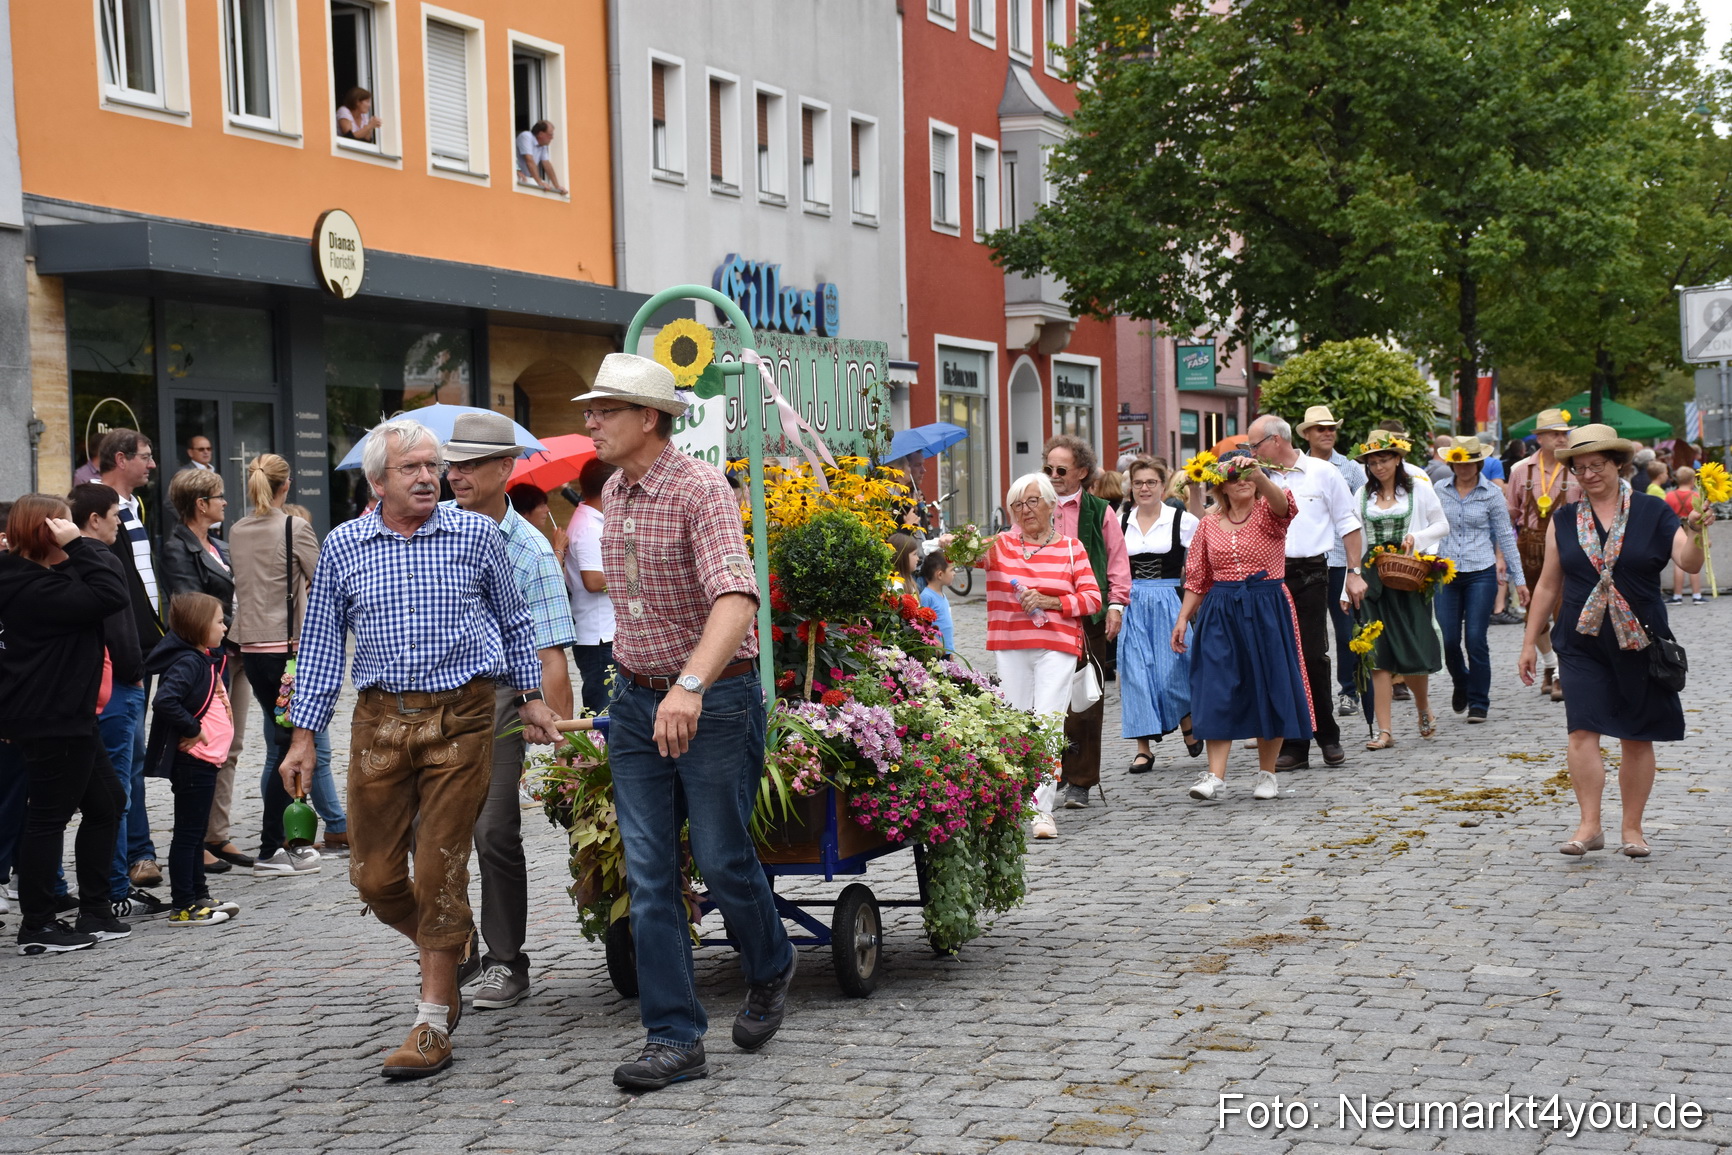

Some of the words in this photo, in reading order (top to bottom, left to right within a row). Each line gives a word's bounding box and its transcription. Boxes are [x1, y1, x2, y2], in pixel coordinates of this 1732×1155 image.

[328, 231, 356, 252] Dianas
[329, 251, 357, 271] Floristik
[1187, 354, 1211, 370] FASS
